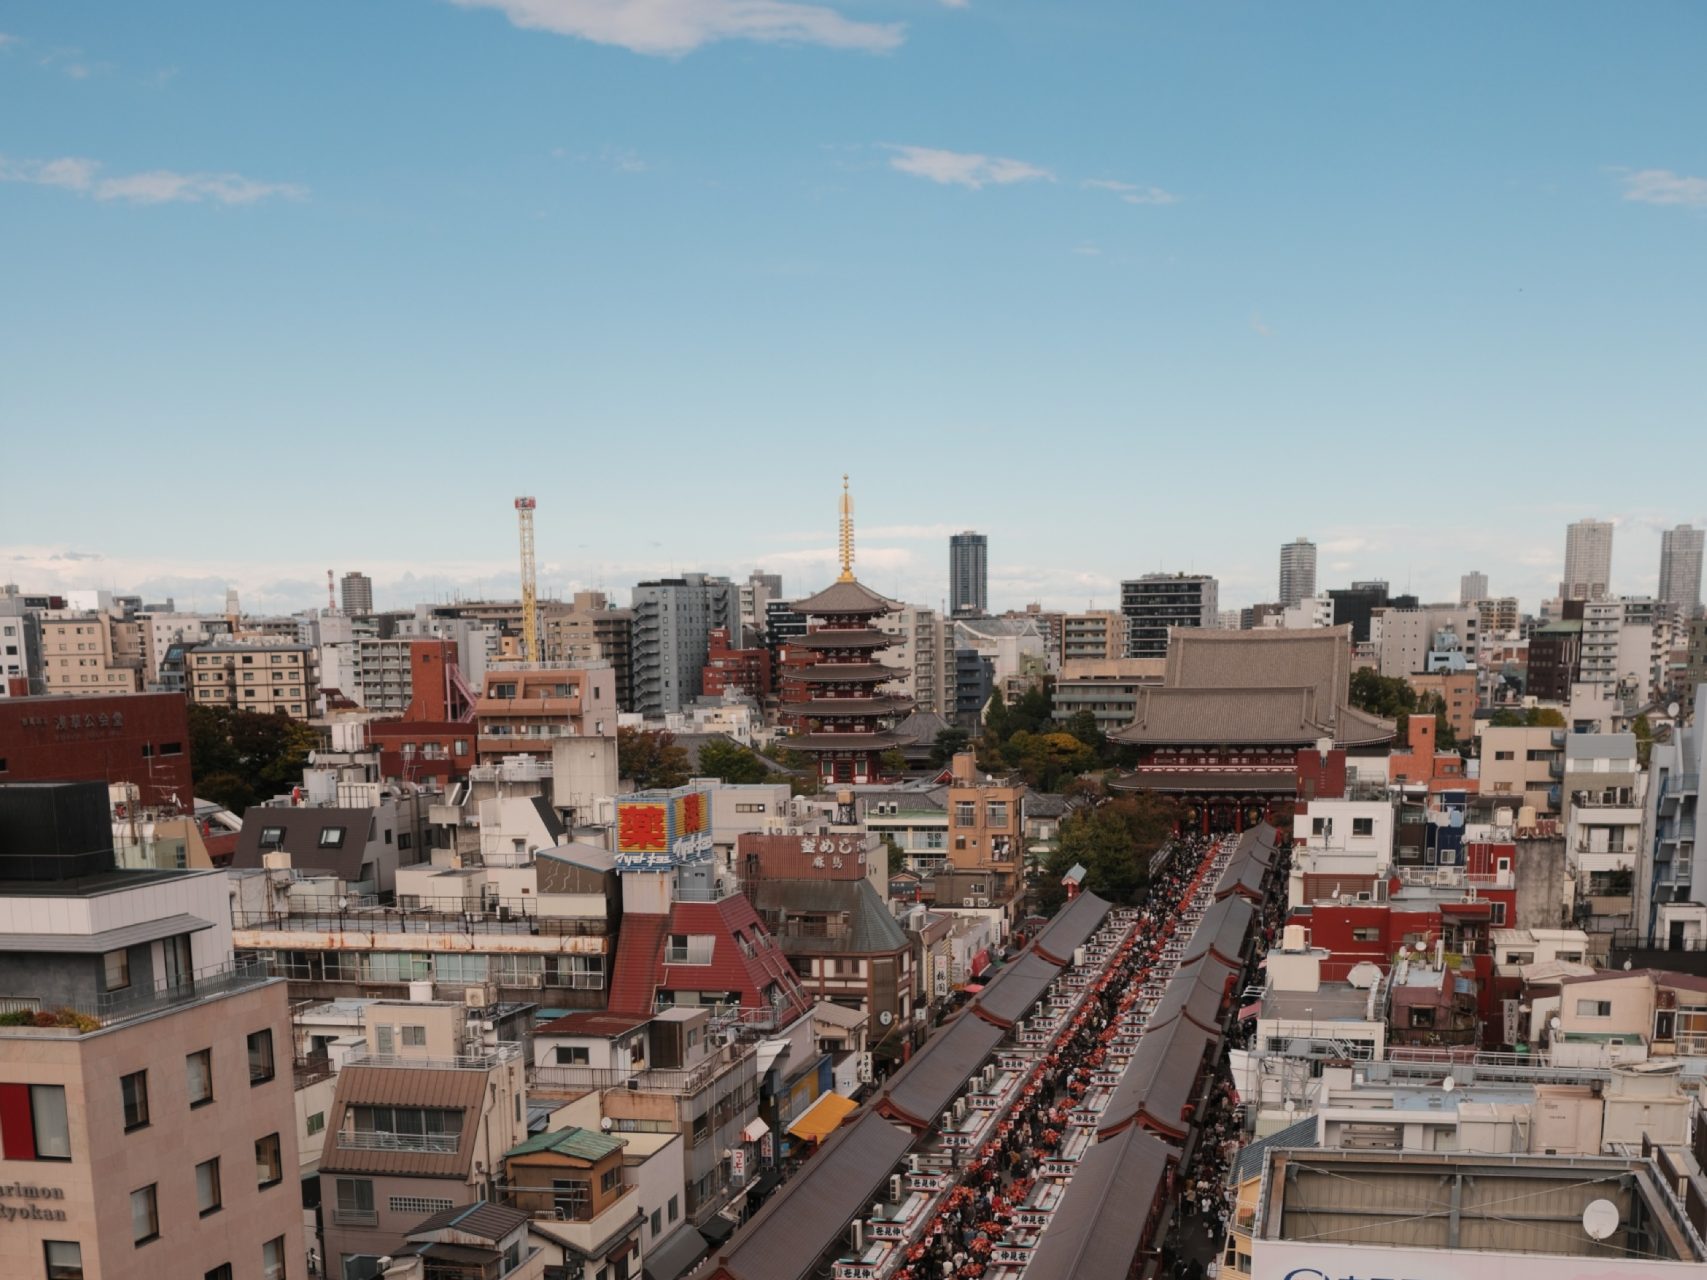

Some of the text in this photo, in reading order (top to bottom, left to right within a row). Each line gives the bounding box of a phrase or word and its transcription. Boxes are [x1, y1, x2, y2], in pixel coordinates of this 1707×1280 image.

[619, 805, 665, 850] 薬
[801, 838, 852, 854] 釜めし
[615, 852, 672, 866] マツモトキヨシ
